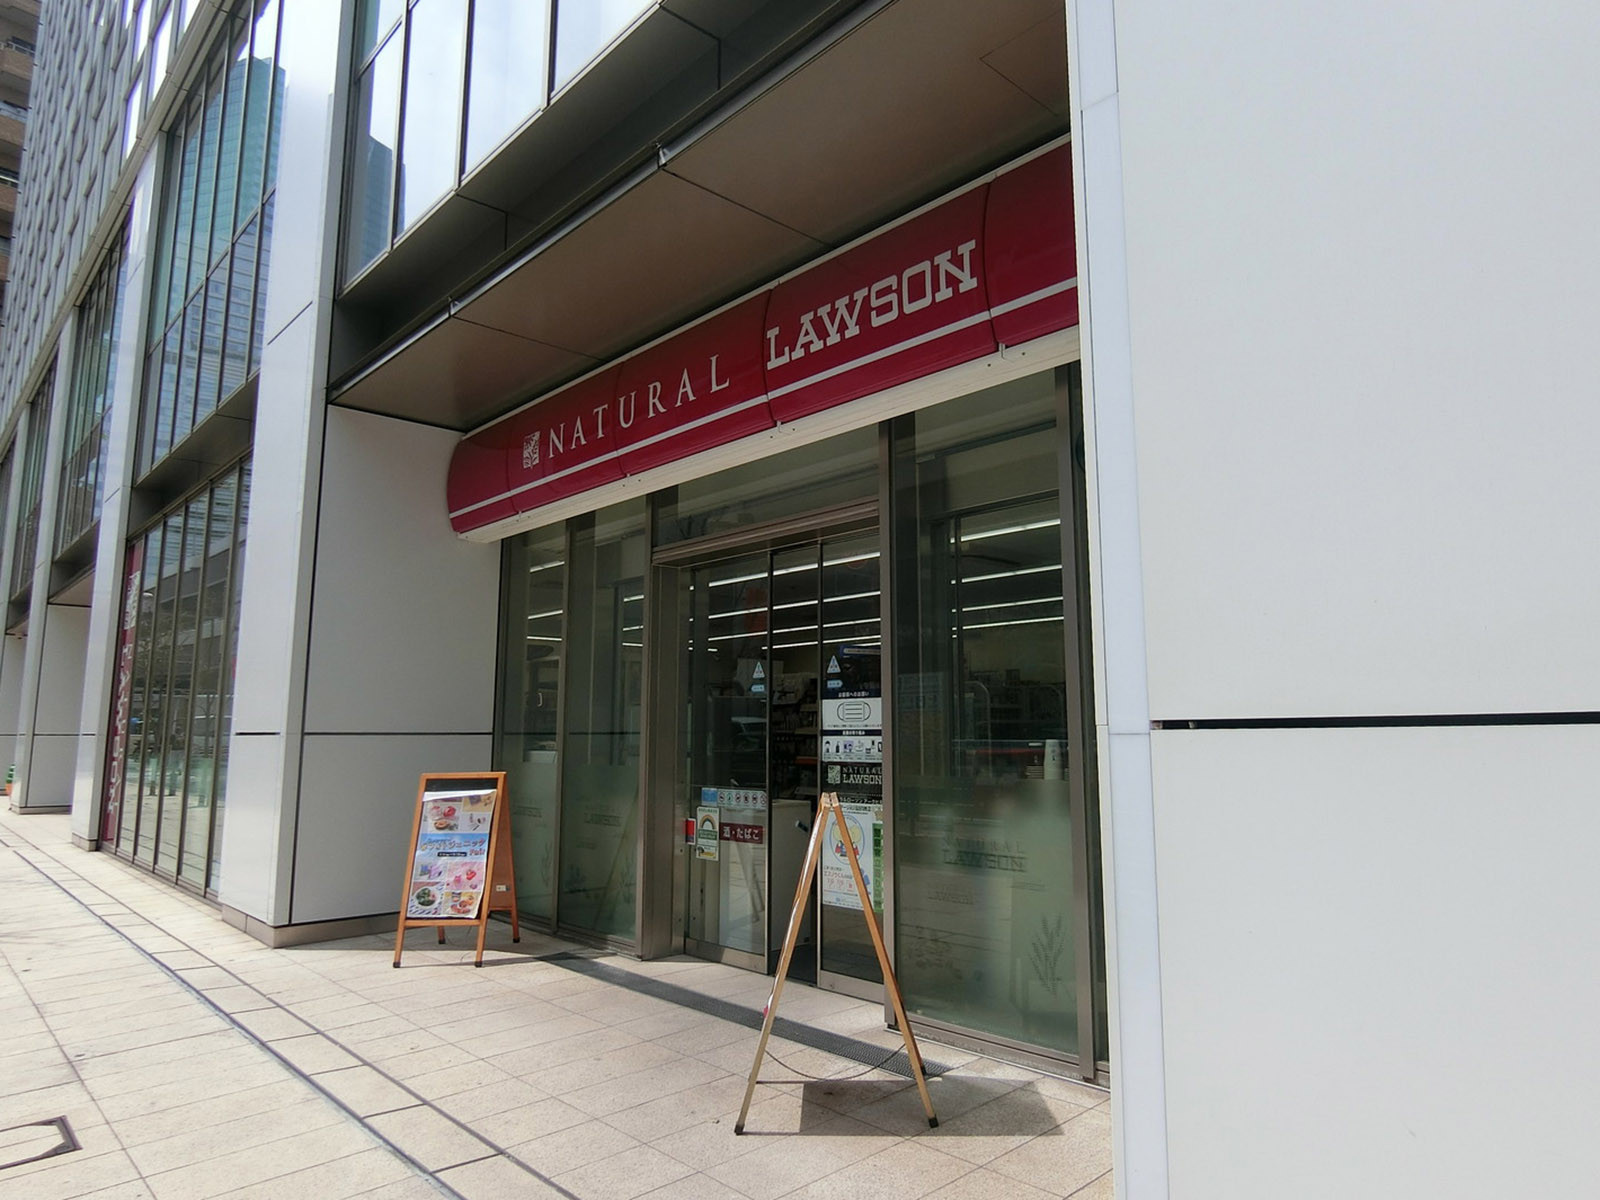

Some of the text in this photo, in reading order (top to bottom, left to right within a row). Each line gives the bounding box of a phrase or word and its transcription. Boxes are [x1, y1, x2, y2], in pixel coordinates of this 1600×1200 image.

[549, 239, 978, 459] NATURAL LAWSON
[842, 766, 882, 775] NATURAL
[842, 773, 882, 785] LAWSON
